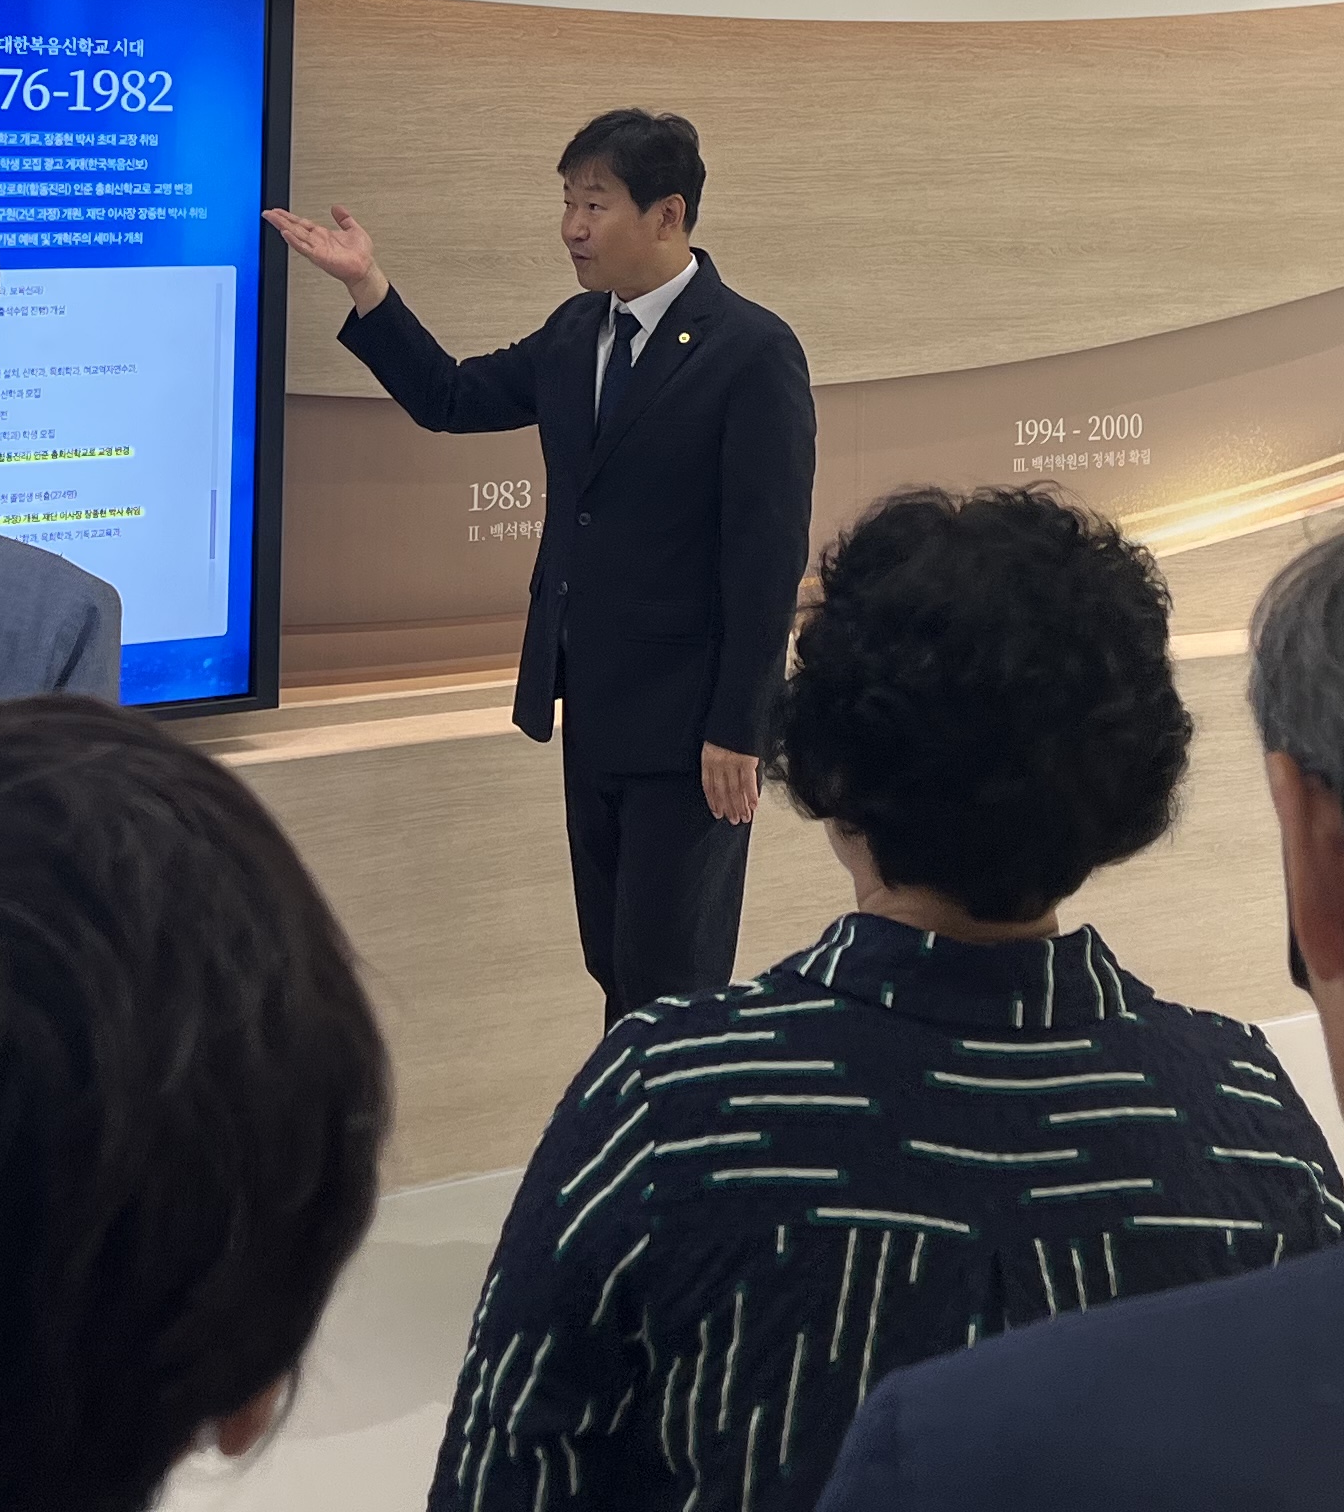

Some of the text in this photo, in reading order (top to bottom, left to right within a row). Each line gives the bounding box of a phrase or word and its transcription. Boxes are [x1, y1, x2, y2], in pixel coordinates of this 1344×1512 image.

[113, 38, 144, 57] 시대
[44, 133, 73, 146] 장종현
[75, 134, 94, 146] 박사
[97, 134, 116, 146] 초대
[118, 134, 137, 146] 교장
[139, 134, 158, 146] 취임
[22, 158, 41, 171] 모집
[44, 158, 64, 171] 광고
[74, 183, 93, 195] 인준
[95, 183, 151, 196] 총회신학교로
[153, 183, 172, 195] 교명
[174, 183, 193, 195] 변경
[37, 208, 60, 221] 과정)
[86, 208, 105, 220] 재단
[108, 208, 136, 220] 이사장
[138, 208, 166, 220] 장종현
[168, 207, 187, 220] 박사
[189, 207, 207, 220] 취임
[18, 232, 38, 246] 예배
[41, 233, 51, 246] 및
[52, 232, 91, 246] 개혁주의
[93, 232, 122, 245] 세미나
[124, 232, 143, 245] 개최
[25, 388, 41, 398] 모집
[22, 430, 37, 440] 학생
[40, 429, 55, 439] 모집
[1014, 417, 1066, 446] 1994
[1088, 413, 1143, 441] 2000
[1032, 452, 1089, 472] 백석학원의
[1092, 450, 1126, 469] 정체성
[1129, 448, 1151, 466] 확립
[468, 479, 531, 512] 1983
[468, 525, 486, 542] II.
